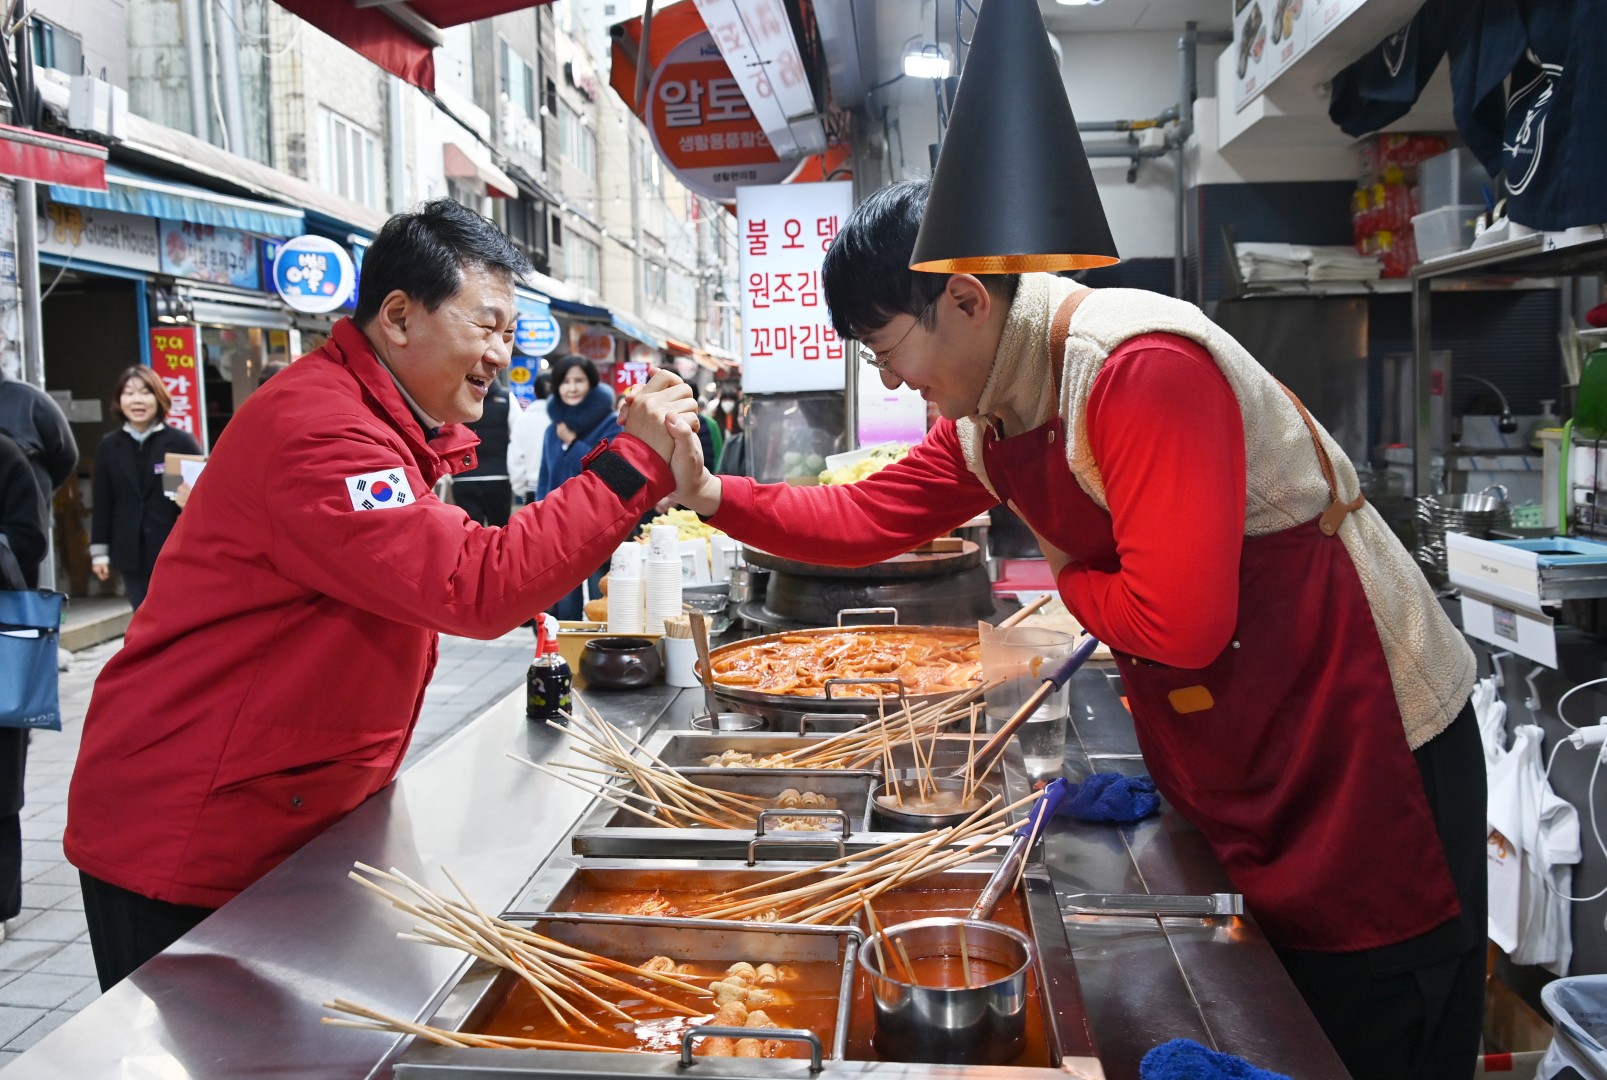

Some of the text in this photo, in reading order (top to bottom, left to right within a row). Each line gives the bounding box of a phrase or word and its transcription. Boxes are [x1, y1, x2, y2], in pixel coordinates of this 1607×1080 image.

[86, 217, 120, 249] Guest
[121, 224, 156, 257] House
[748, 270, 827, 309] 원조김
[750, 323, 844, 361] 꼬마김밥
